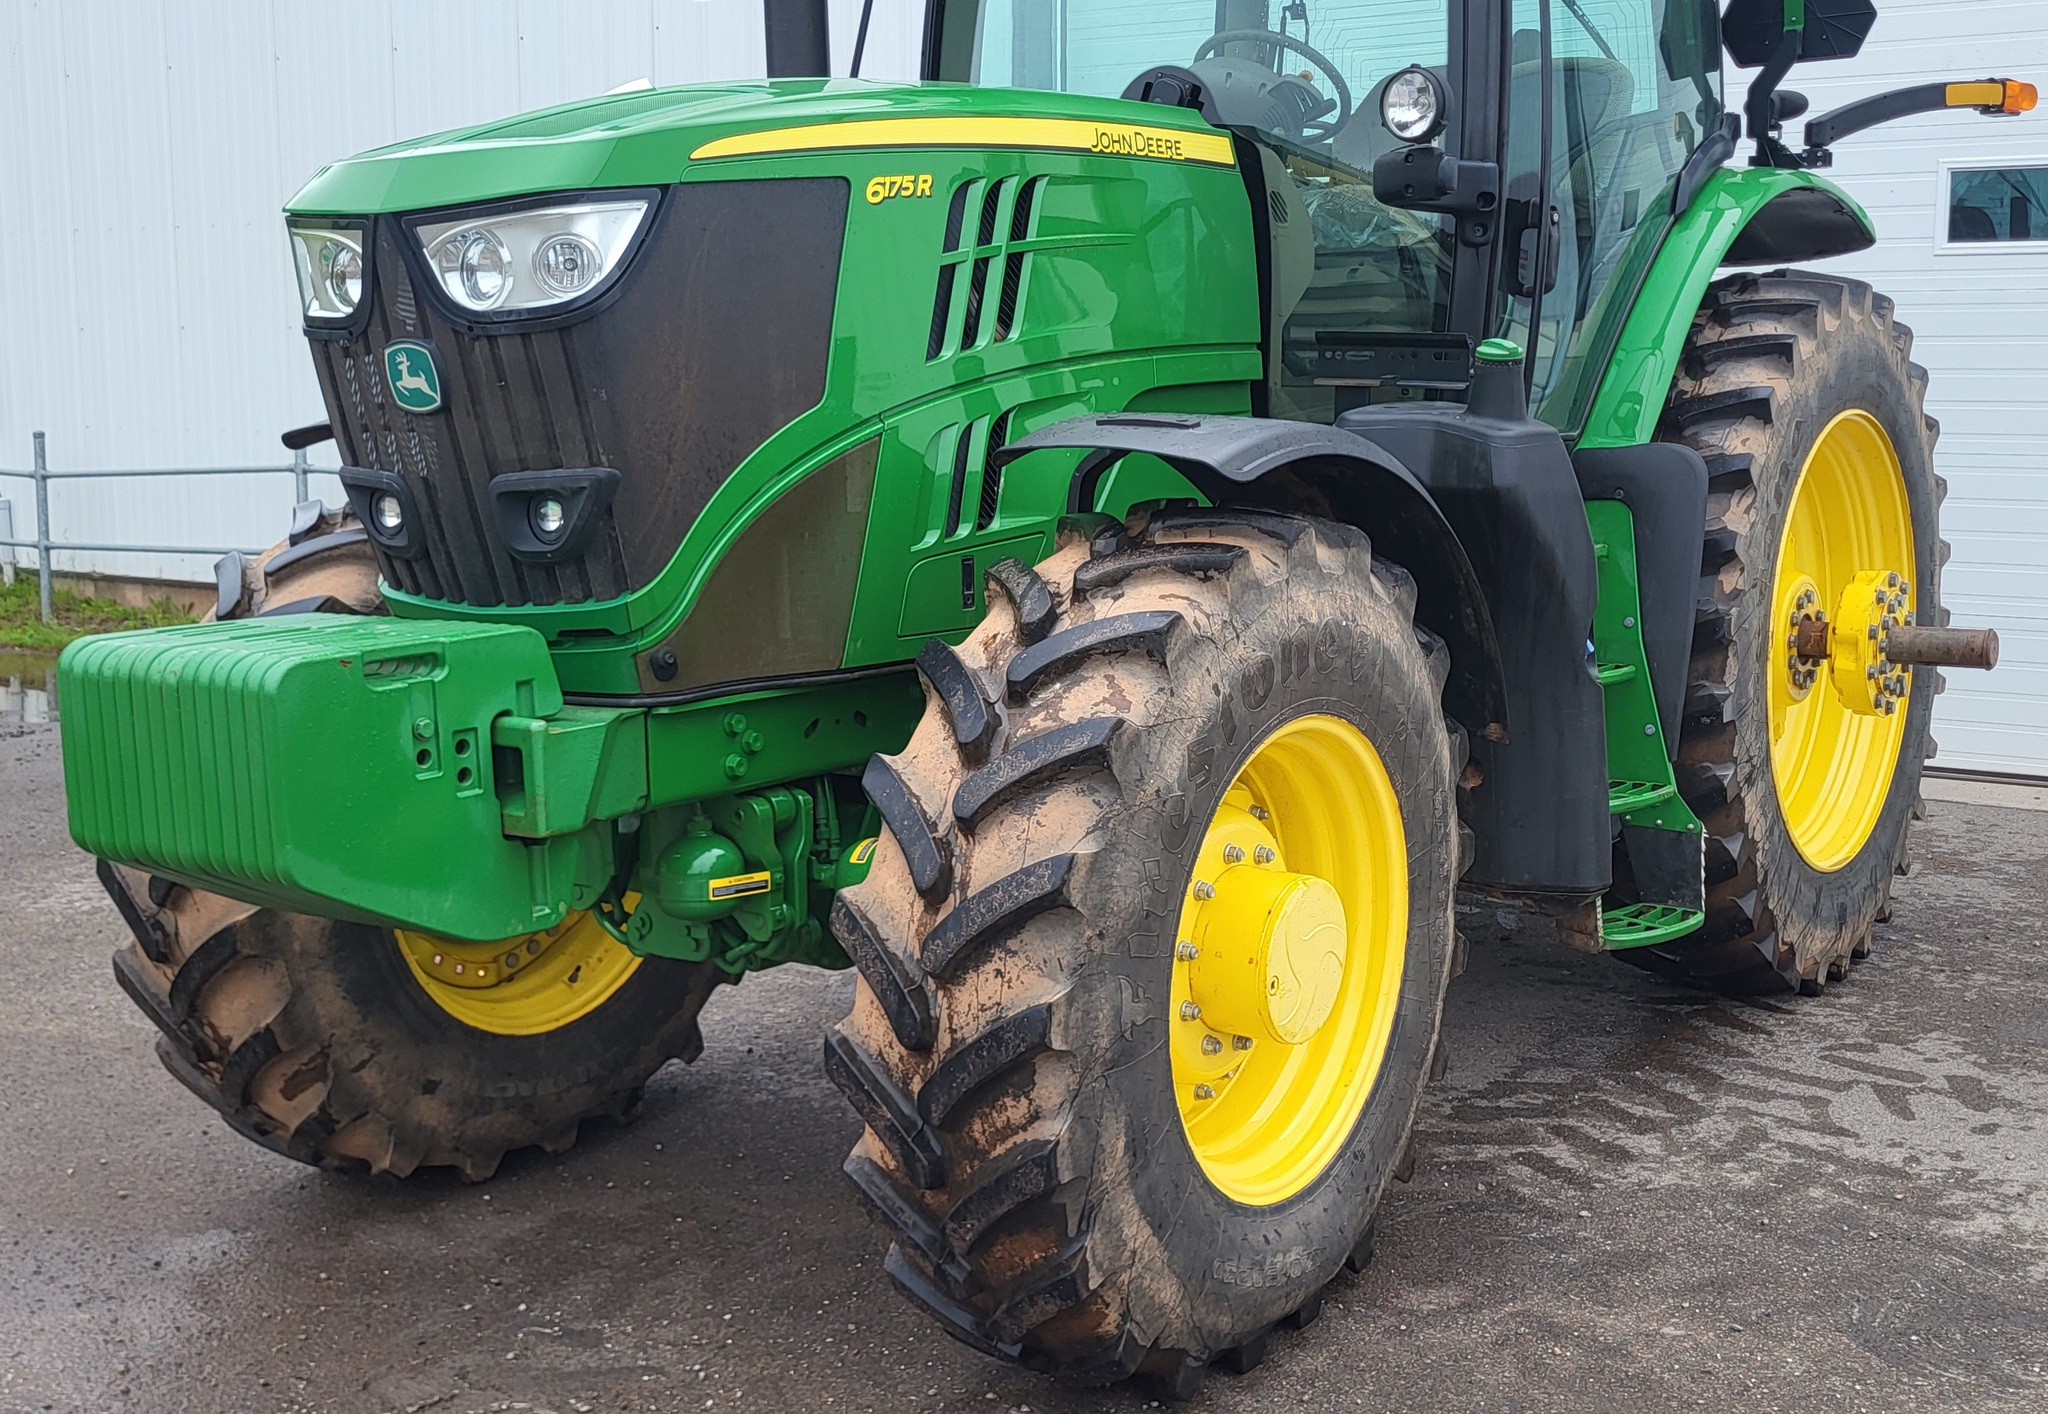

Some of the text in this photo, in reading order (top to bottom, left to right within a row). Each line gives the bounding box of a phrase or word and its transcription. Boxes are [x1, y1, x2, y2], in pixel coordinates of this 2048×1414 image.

[1091, 127, 1183, 157] JOHN DEERE
[865, 174, 933, 205] 6175R
